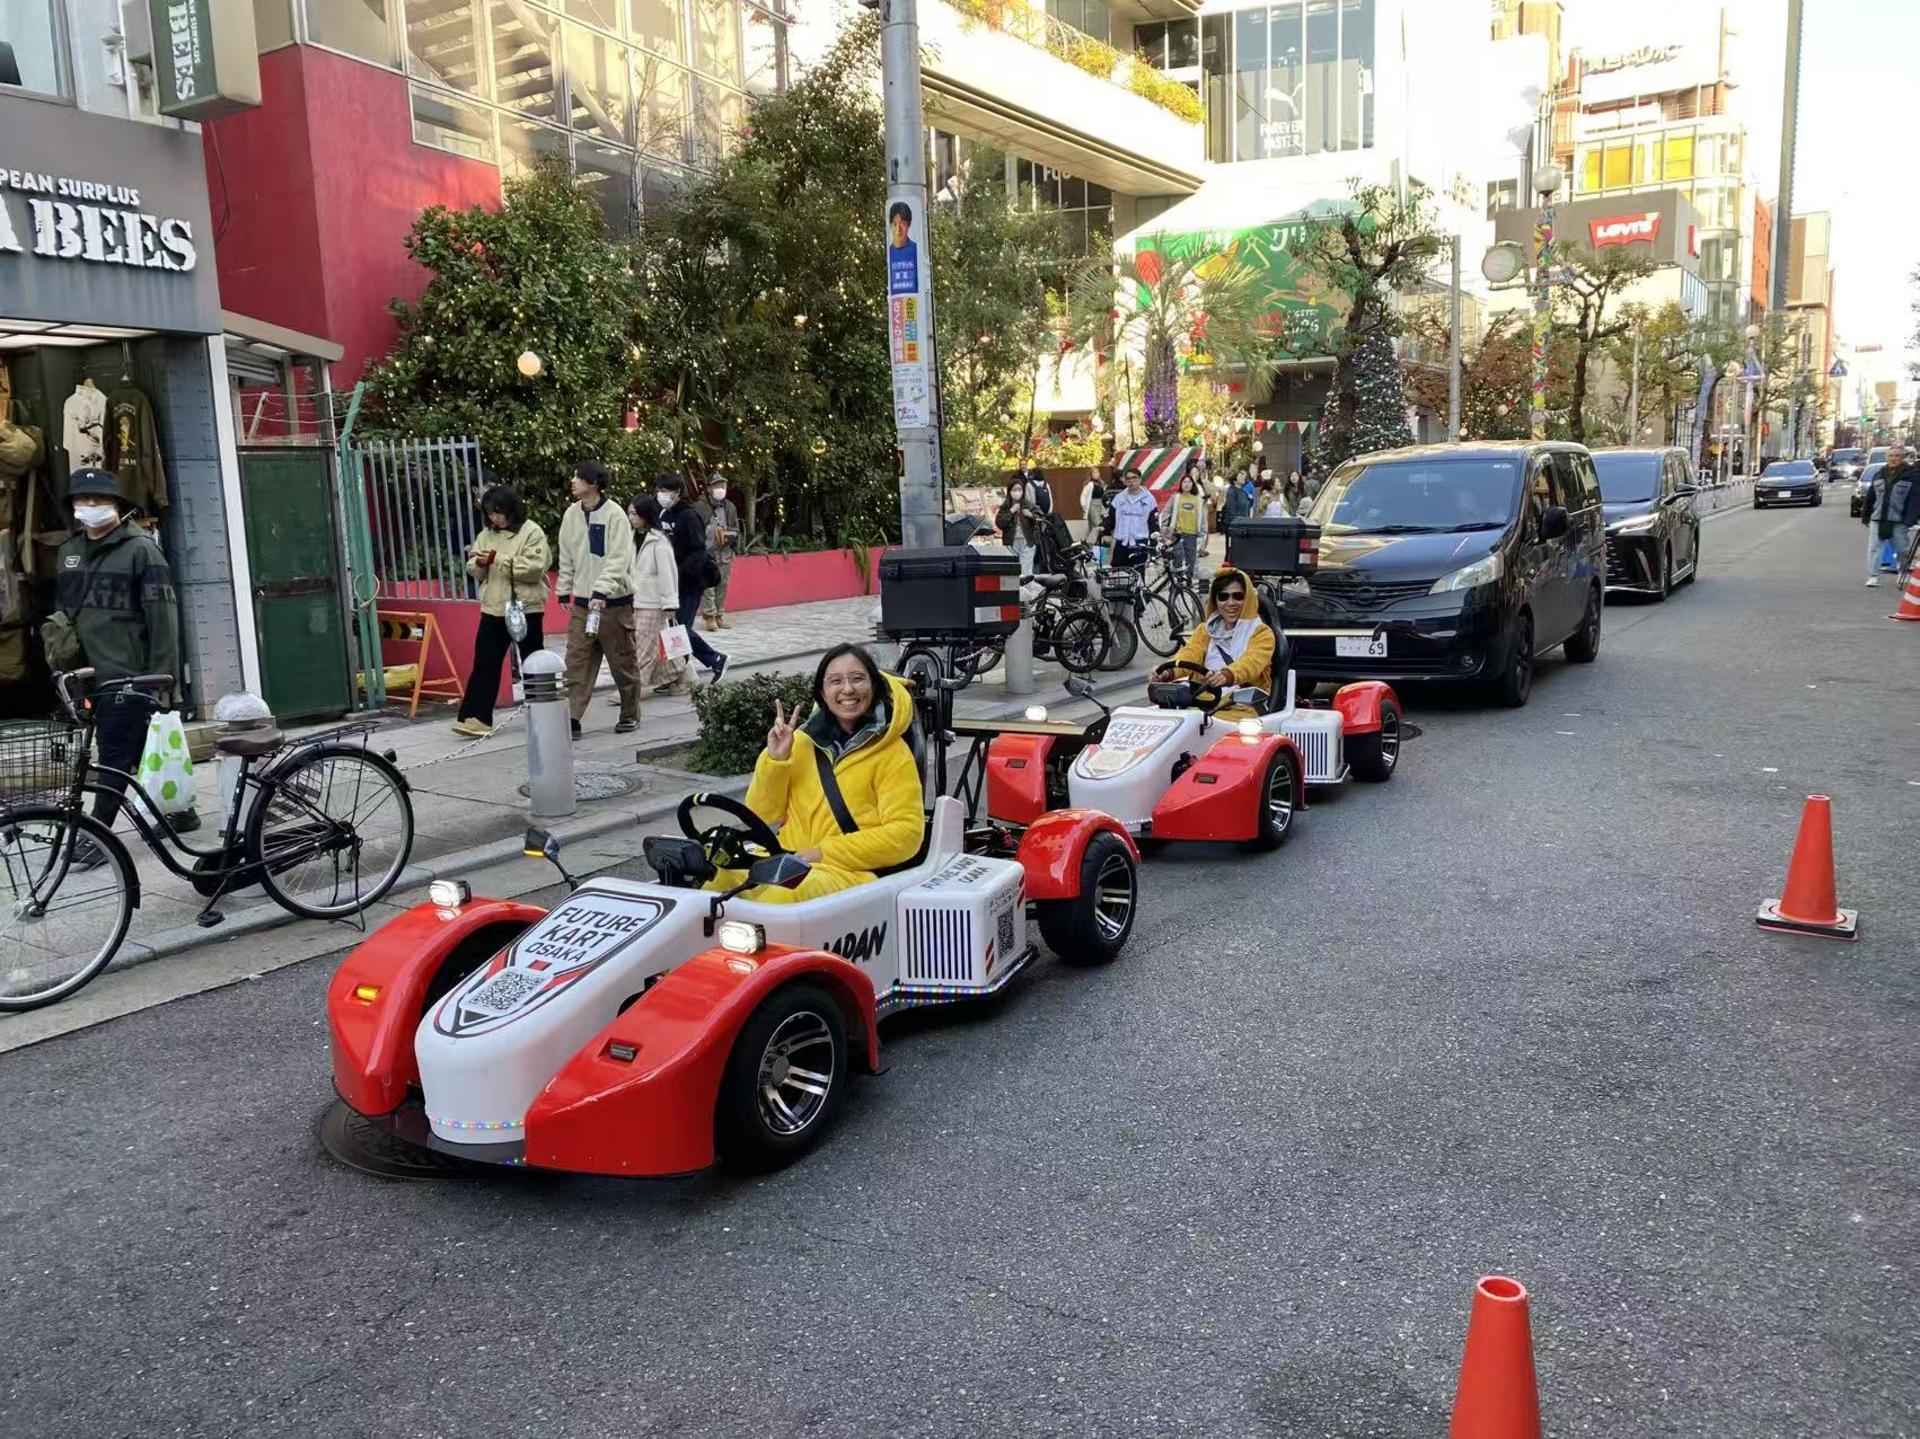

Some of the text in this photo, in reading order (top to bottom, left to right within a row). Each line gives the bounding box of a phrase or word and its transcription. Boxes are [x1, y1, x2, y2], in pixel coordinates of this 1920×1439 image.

[168, 1, 196, 101] BEES
[58, 177, 141, 207] SURPLUS
[28, 198, 197, 272] BEES
[1368, 642, 1384, 655] 69
[1108, 730, 1156, 741] KART
[1109, 722, 1171, 733] FUTURE
[552, 907, 646, 934] FUTURE
[541, 923, 616, 950] KART
[524, 942, 588, 964] OSAKA
